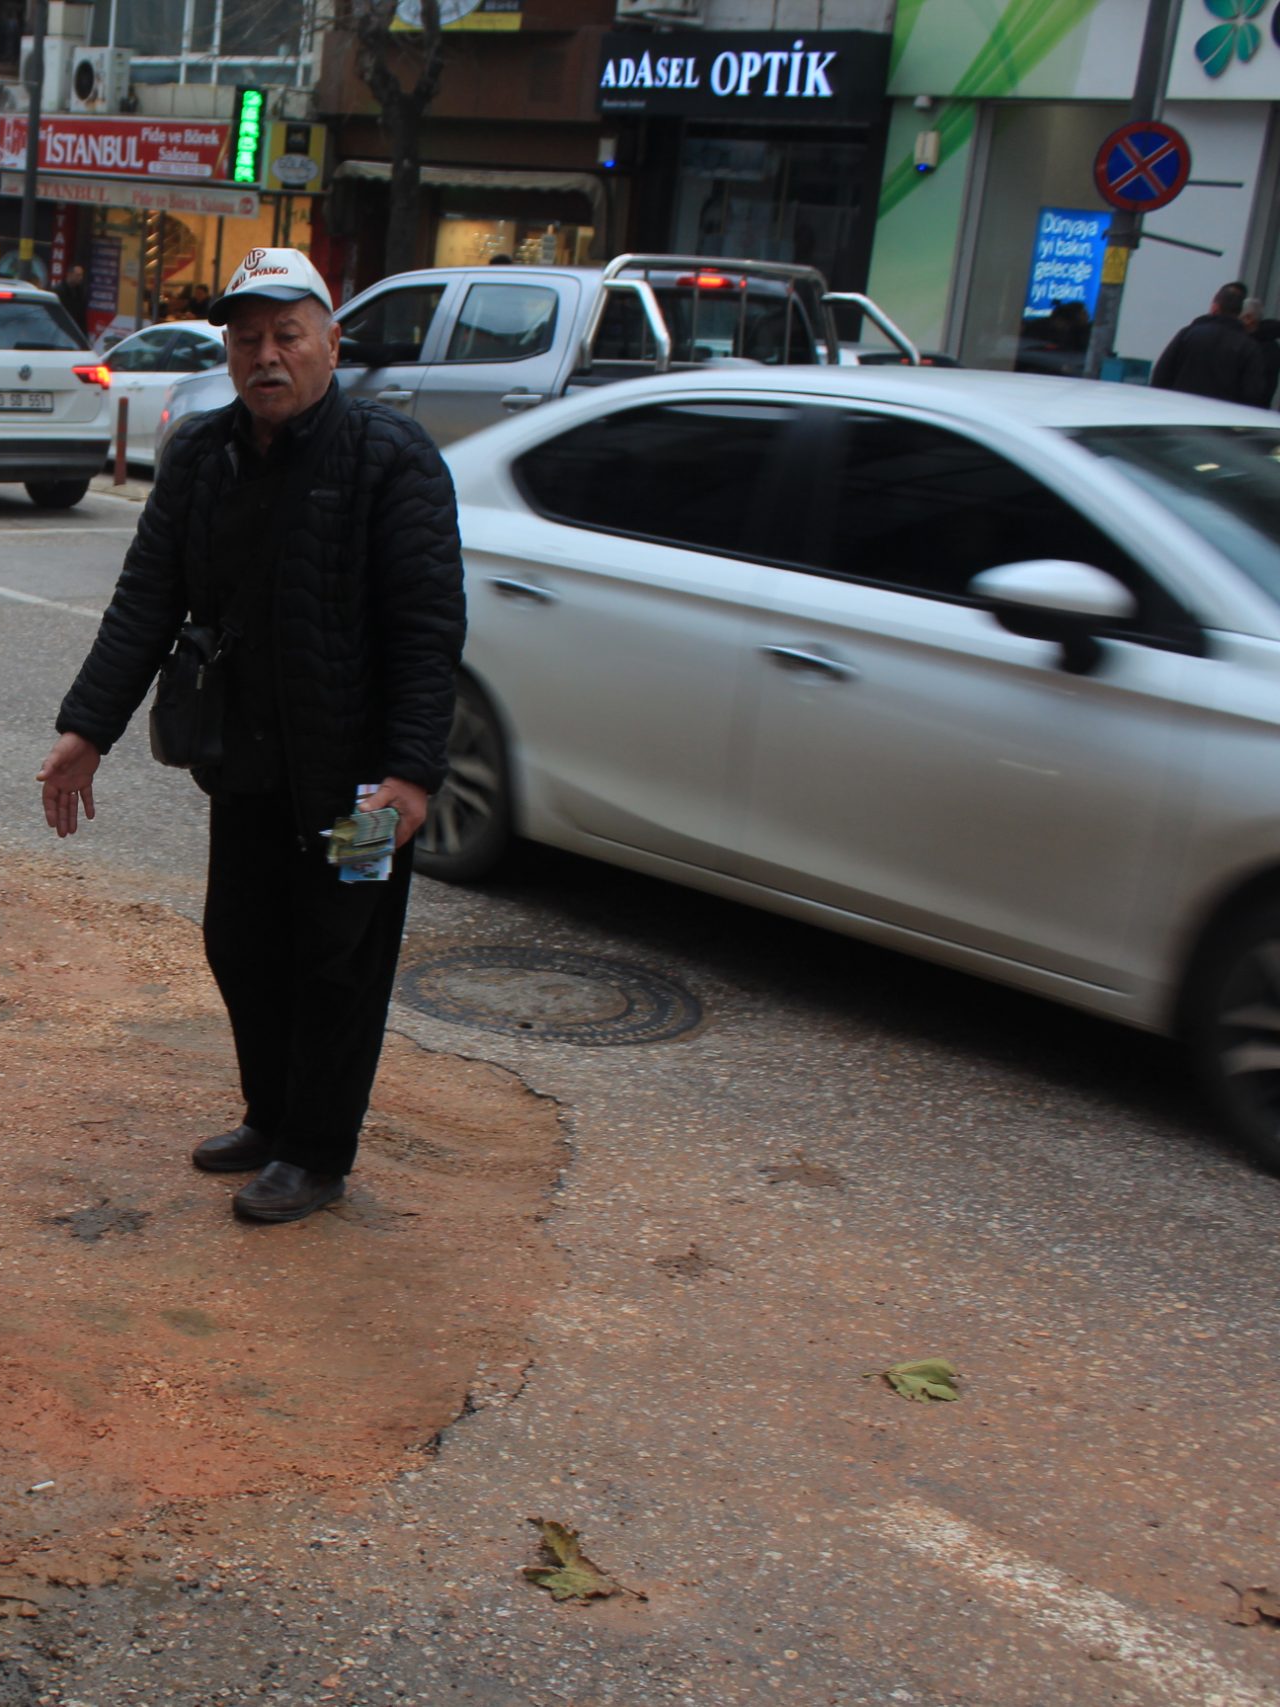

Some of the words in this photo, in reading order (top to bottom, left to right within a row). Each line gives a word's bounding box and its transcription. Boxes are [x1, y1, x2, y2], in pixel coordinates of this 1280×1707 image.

[600, 50, 700, 88] ADASEL
[710, 40, 837, 97] OPTİK
[45, 125, 144, 169] İSTANBUL
[141, 127, 166, 143] Pide
[168, 131, 182, 144] ve
[1041, 212, 1099, 241] Dünyaya
